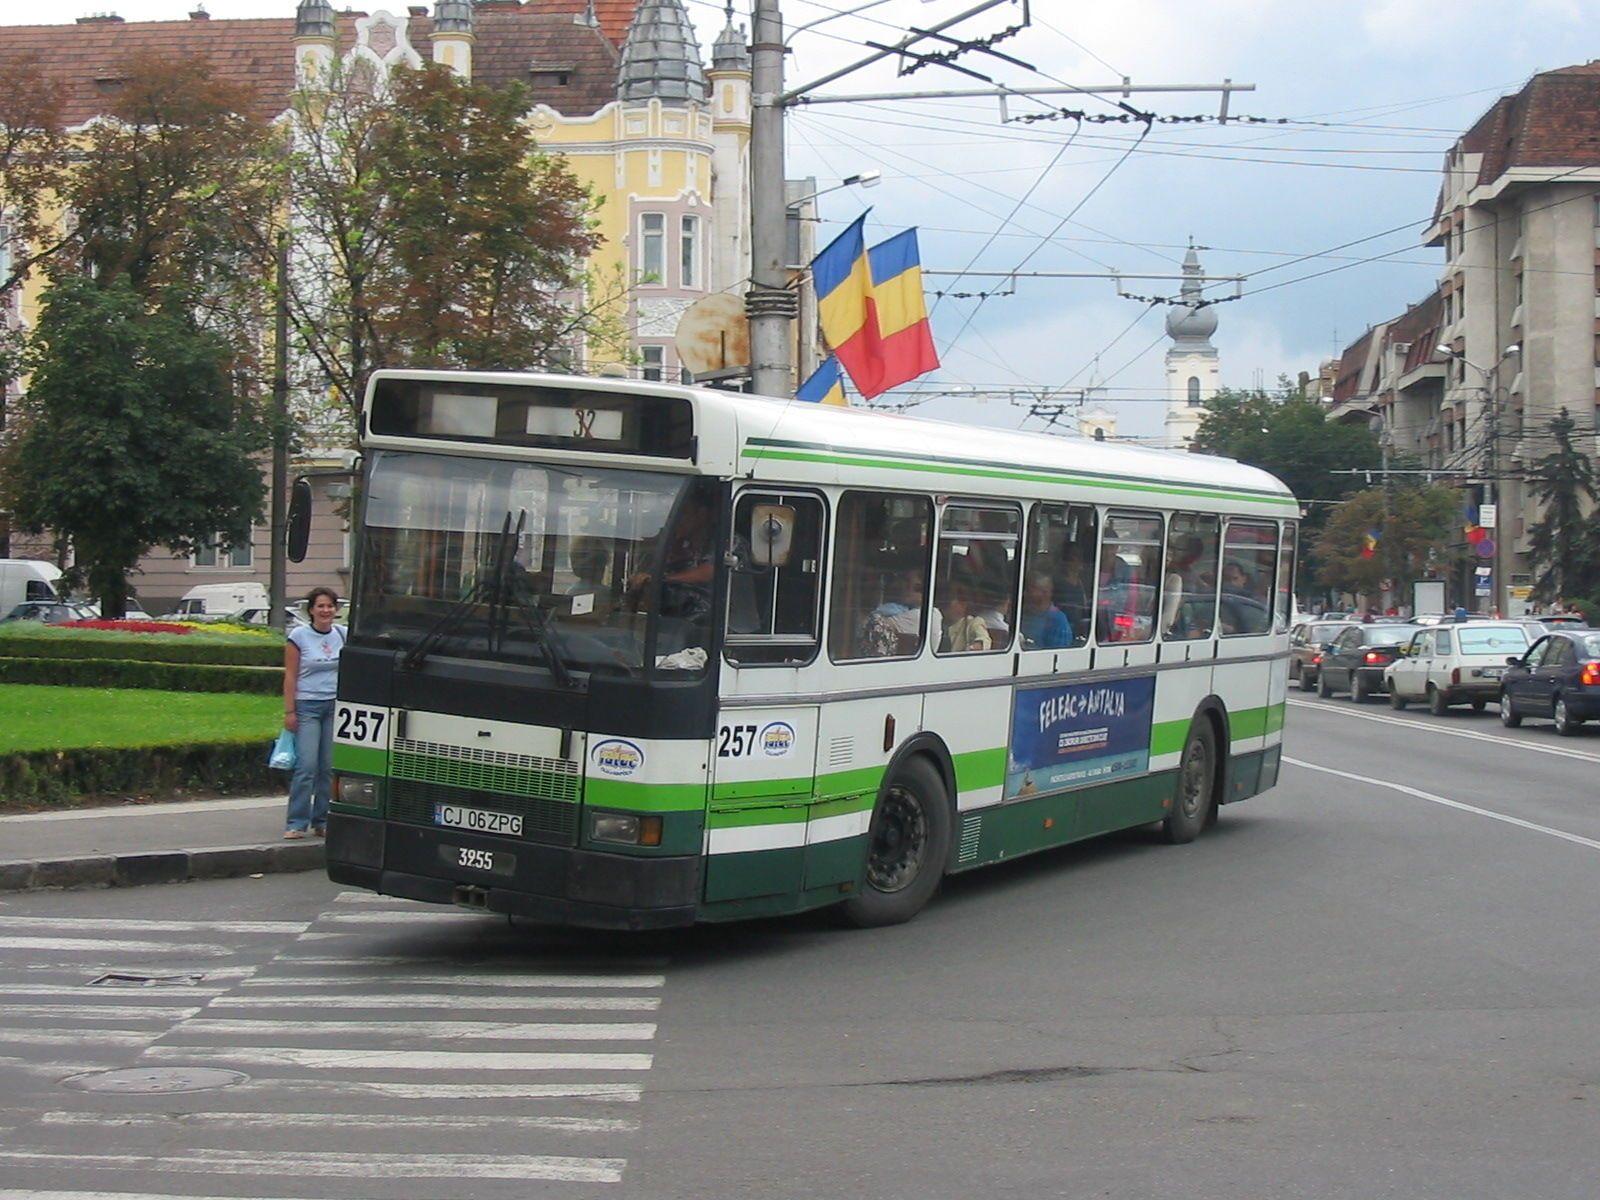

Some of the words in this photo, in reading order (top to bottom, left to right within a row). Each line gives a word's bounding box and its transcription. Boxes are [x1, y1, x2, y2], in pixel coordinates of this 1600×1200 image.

[337, 707, 385, 742] 257
[1040, 693, 1078, 733] FELEAC
[1087, 689, 1124, 717] ANTALYA
[718, 725, 757, 757] 257
[443, 807, 462, 825] CJ
[458, 847, 493, 870] 3255
